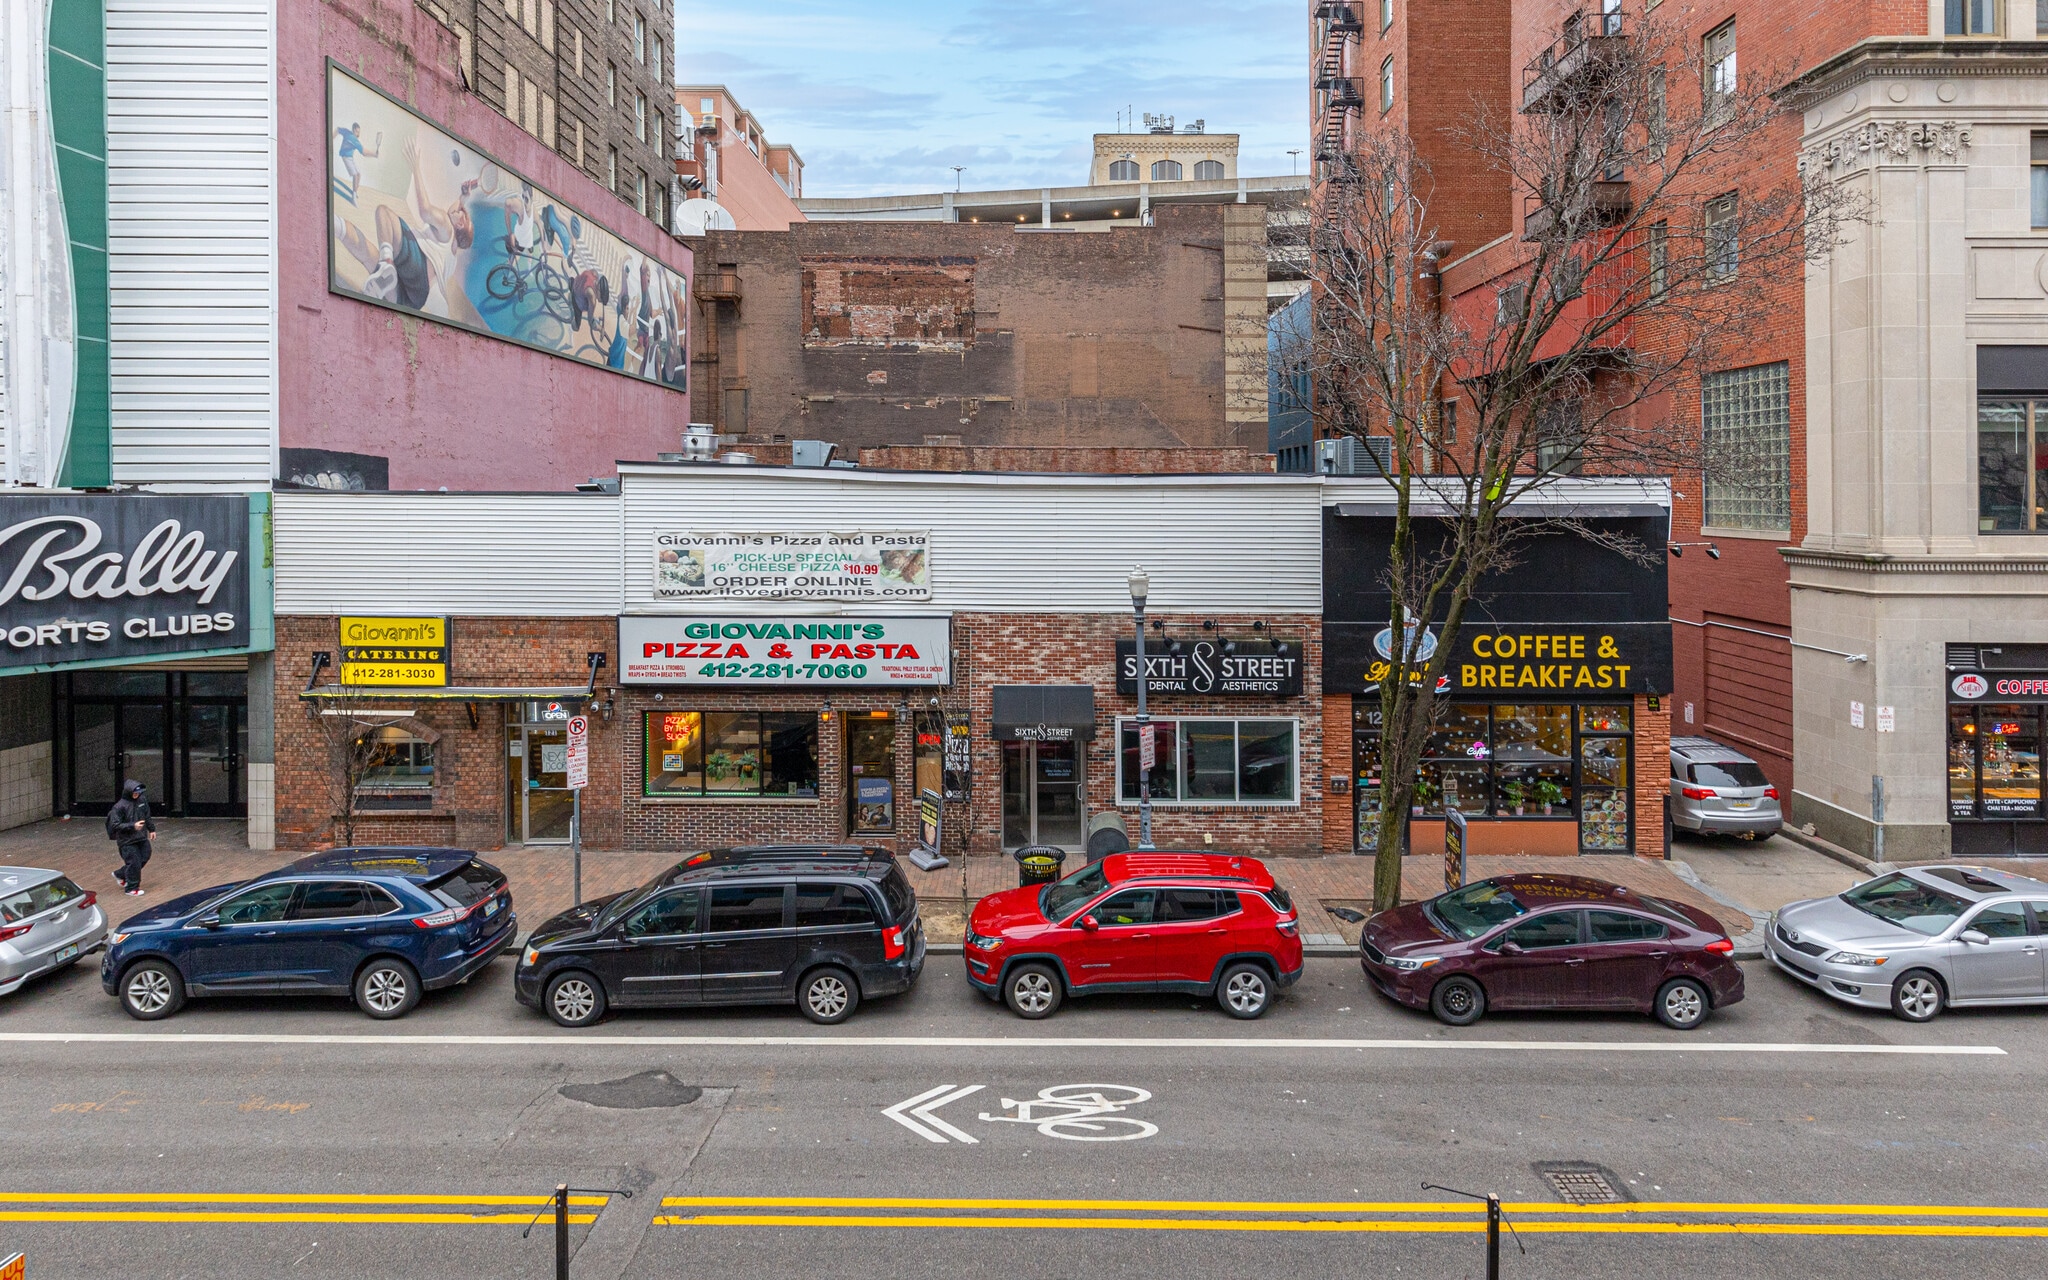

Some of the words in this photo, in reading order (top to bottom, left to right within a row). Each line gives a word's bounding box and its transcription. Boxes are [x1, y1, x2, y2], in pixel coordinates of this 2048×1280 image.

[657, 535, 763, 547] Giovanni's
[771, 536, 822, 546] Pizza
[828, 535, 864, 546] and
[872, 535, 926, 546] Pasta
[0, 515, 238, 606] Bally
[734, 553, 792, 563] PICK-UP
[796, 553, 852, 562] SPECIAL
[739, 563, 796, 572] CHEESE
[800, 563, 841, 572] PIZZA
[843, 564, 878, 575] $10.99
[713, 577, 787, 587] ORDER
[794, 577, 873, 587] ONLINE
[659, 587, 927, 598] www.ilovegiovannis.com
[123, 612, 235, 639] CLUBS
[347, 623, 436, 642] Giovanni's
[684, 623, 885, 640] GIOVANNI'S
[643, 643, 750, 659] PIZZA
[768, 643, 793, 660] &
[811, 643, 921, 660] PASTA
[1472, 635, 1585, 658] COFFEE
[1597, 635, 1620, 658] &
[347, 650, 440, 660] CATERING
[1124, 658, 1186, 677] SXTH
[1222, 658, 1296, 677] STREET
[353, 669, 435, 679] 412-281-3030
[1461, 664, 1631, 688] BREAKFAST
[1149, 681, 1186, 691] DENTAL
[1222, 681, 1279, 691] AESTHETICS
[666, 716, 686, 725] PIZZA
[676, 725, 690, 733] THE
[1015, 728, 1037, 737] SIXTH
[1047, 728, 1073, 736] STREET
[666, 733, 688, 741] SLICE
[918, 734, 941, 745] OPEN
